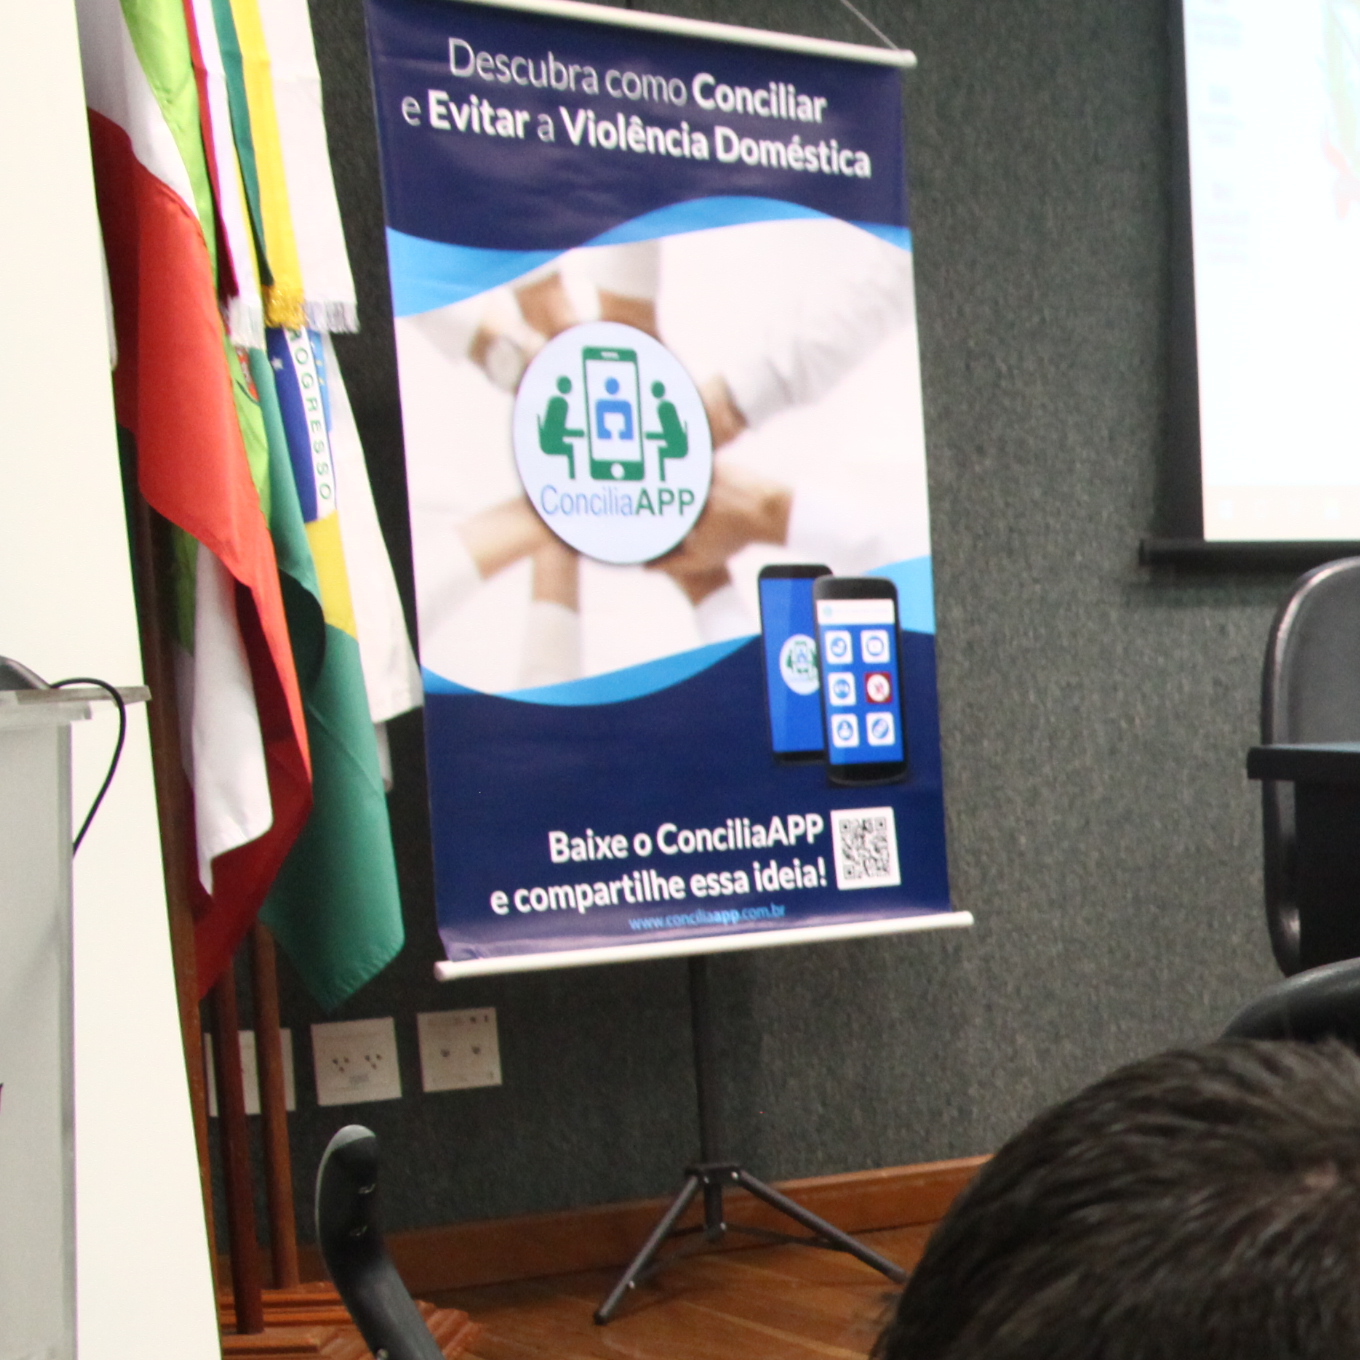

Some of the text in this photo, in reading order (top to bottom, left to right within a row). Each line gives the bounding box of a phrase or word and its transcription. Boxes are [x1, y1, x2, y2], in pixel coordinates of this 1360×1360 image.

[448, 37, 827, 122] Descubra como Conciliar
[402, 90, 872, 178] e Evitar a Violência Doméstica
[540, 484, 696, 518] ConciliaAPP
[548, 813, 824, 863] Baixe o ConciliaAPP
[490, 857, 828, 915] e compartilhe essa ideia!
[628, 902, 786, 931] www.conciliaapp.com.br
